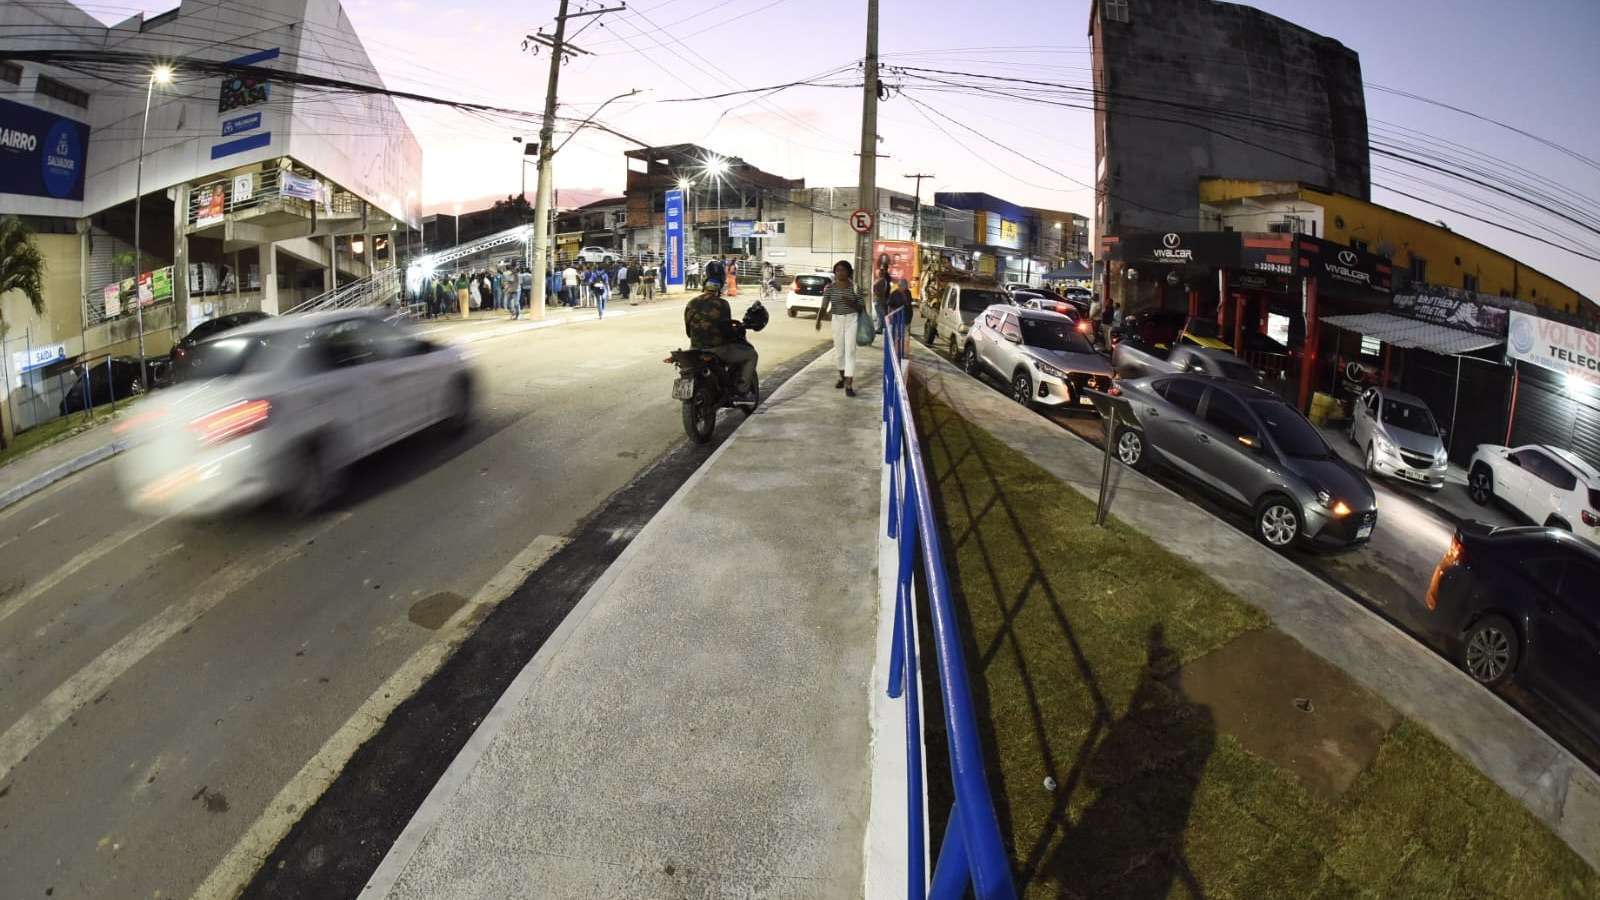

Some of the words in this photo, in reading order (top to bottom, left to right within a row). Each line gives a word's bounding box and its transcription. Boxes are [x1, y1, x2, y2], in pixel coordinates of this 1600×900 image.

[47, 154, 75, 171] SALVADOR
[857, 214, 866, 228] E
[1536, 318, 1600, 358] VOLTS
